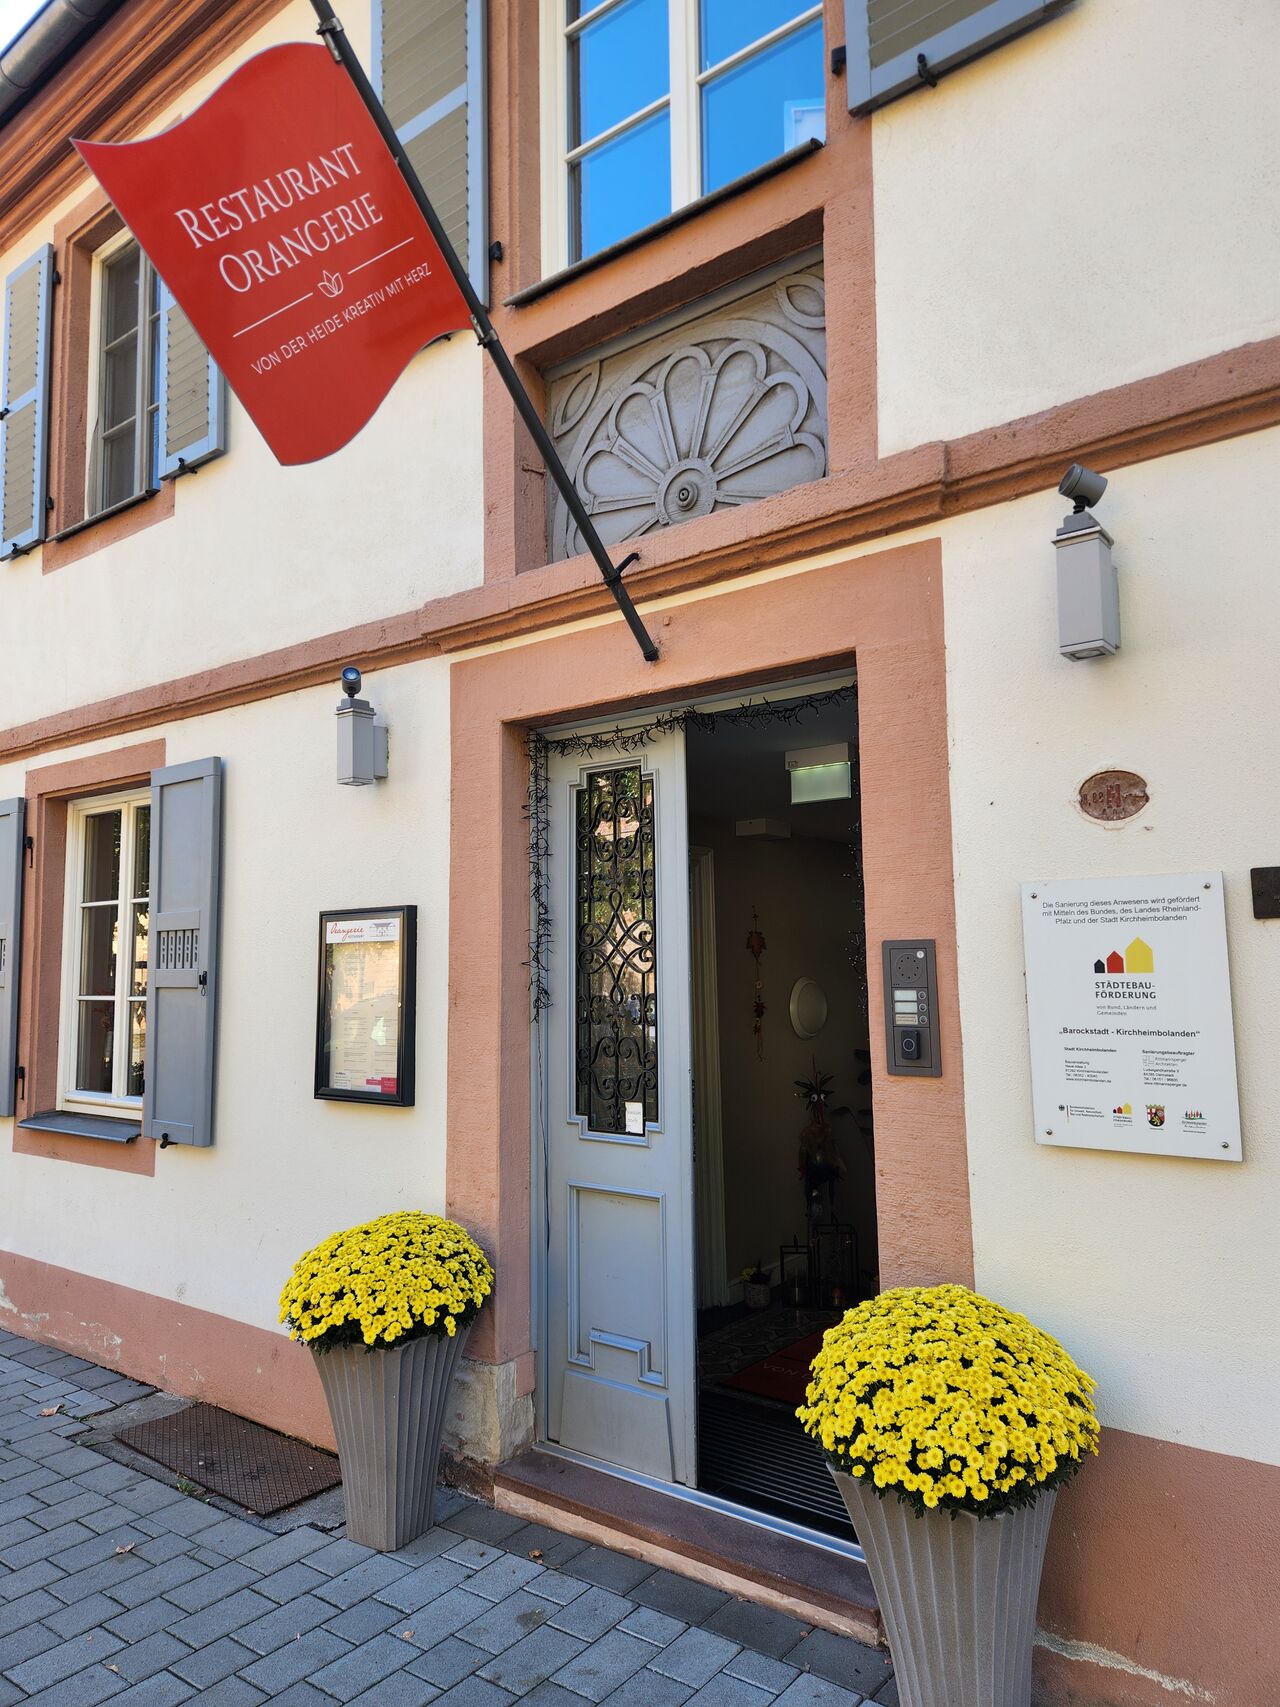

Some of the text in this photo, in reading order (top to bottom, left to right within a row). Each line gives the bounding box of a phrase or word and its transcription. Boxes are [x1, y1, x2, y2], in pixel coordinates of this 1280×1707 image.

[174, 142, 362, 248] RESTAURANT
[218, 192, 383, 293] ORANGERIE
[251, 262, 432, 375] VON DER HEIDE KREATIV MIT HERZ
[1095, 980, 1155, 989] STÄDTEBAU-
[1096, 991, 1156, 999] FÖRDERUNG
[1059, 1027, 1109, 1035] „Barockstadt
[1116, 1028, 1200, 1037] Kirchheimbolanden“
